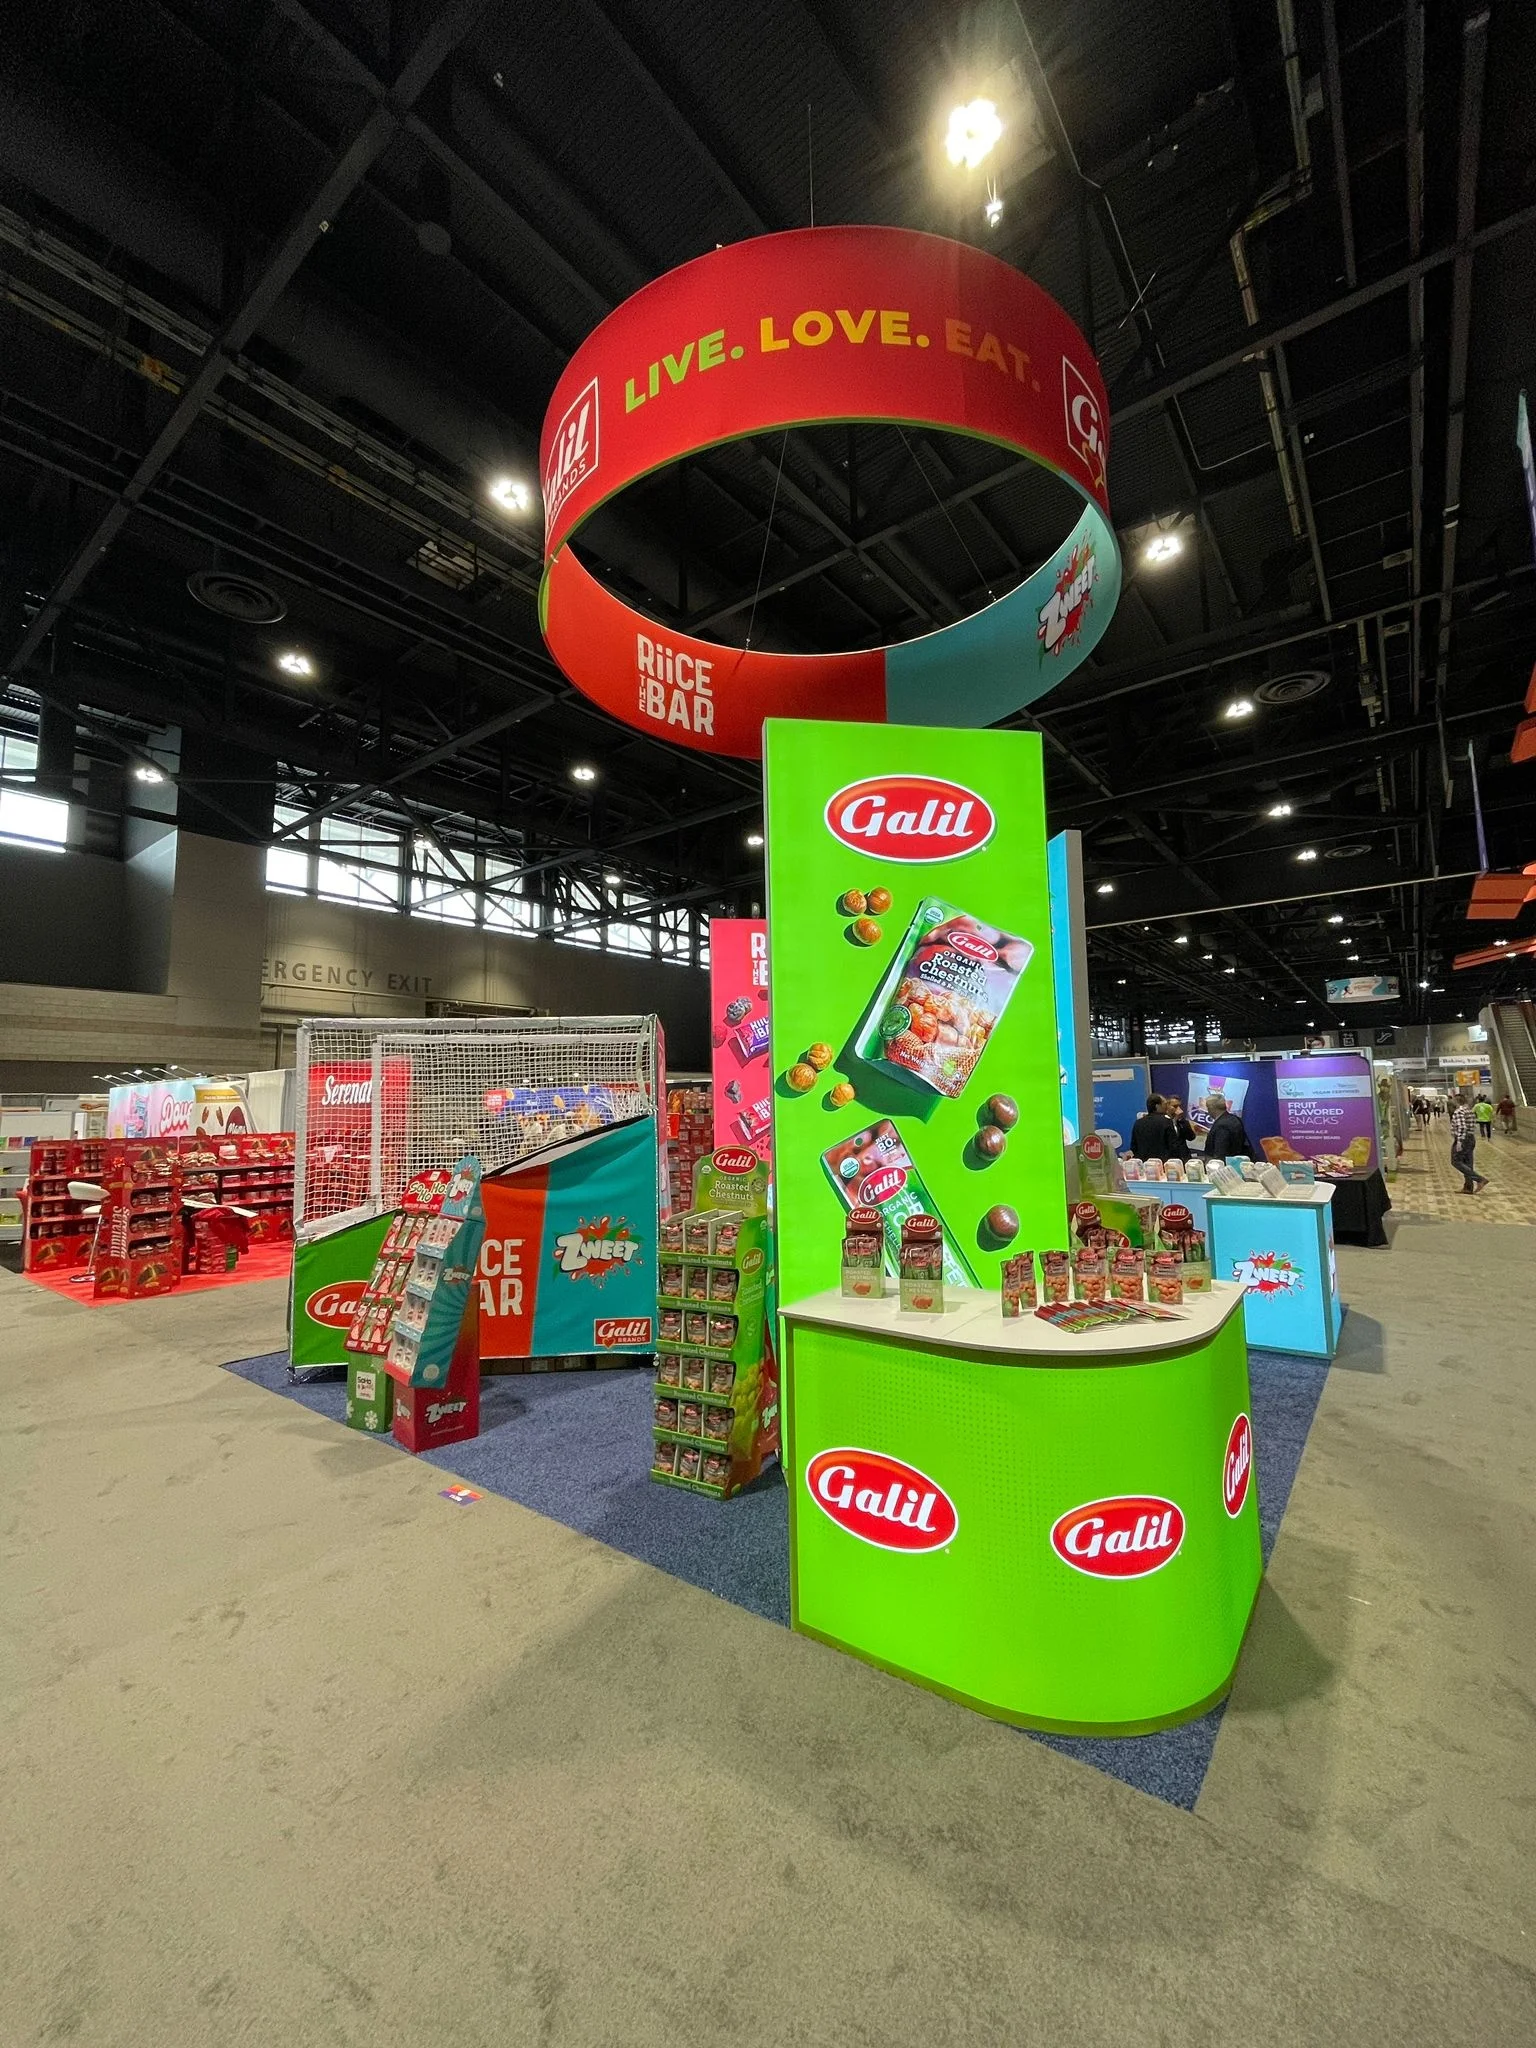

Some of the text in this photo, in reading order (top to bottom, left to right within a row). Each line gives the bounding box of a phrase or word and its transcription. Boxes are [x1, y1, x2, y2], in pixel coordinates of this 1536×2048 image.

[625, 309, 1042, 413] LIVE. LOVE. EAT.
[1039, 555, 1096, 652] ZWEET
[638, 673, 715, 737] THE BAR
[840, 795, 975, 837] Galil
[951, 935, 995, 959] Galil
[931, 952, 988, 986] Roasted
[943, 950, 985, 974] ORGANIC
[387, 973, 433, 994] EXIT
[919, 961, 989, 1003] Chestnuts
[1288, 1101, 1318, 1109] FRUIT
[1288, 1108, 1344, 1116] FLAVORED
[1288, 1116, 1340, 1125] SNACKS
[875, 1132, 890, 1145] JUST
[715, 1153, 753, 1168] Galil
[708, 1189, 754, 1200] Chestnuts
[715, 1180, 750, 1191] Roasted
[863, 1170, 902, 1203] Galil
[851, 1210, 877, 1219] Galil
[907, 1218, 935, 1228] Galil
[1163, 1208, 1187, 1218] Galil
[556, 1232, 639, 1272] ZWEET
[1233, 1260, 1300, 1287] ZWEET
[598, 1321, 648, 1337] Galil
[617, 1335, 647, 1343] BRANDS
[1227, 1424, 1250, 1502] Galil
[818, 1466, 936, 1532] Galil
[1065, 1511, 1173, 1557] Galil
